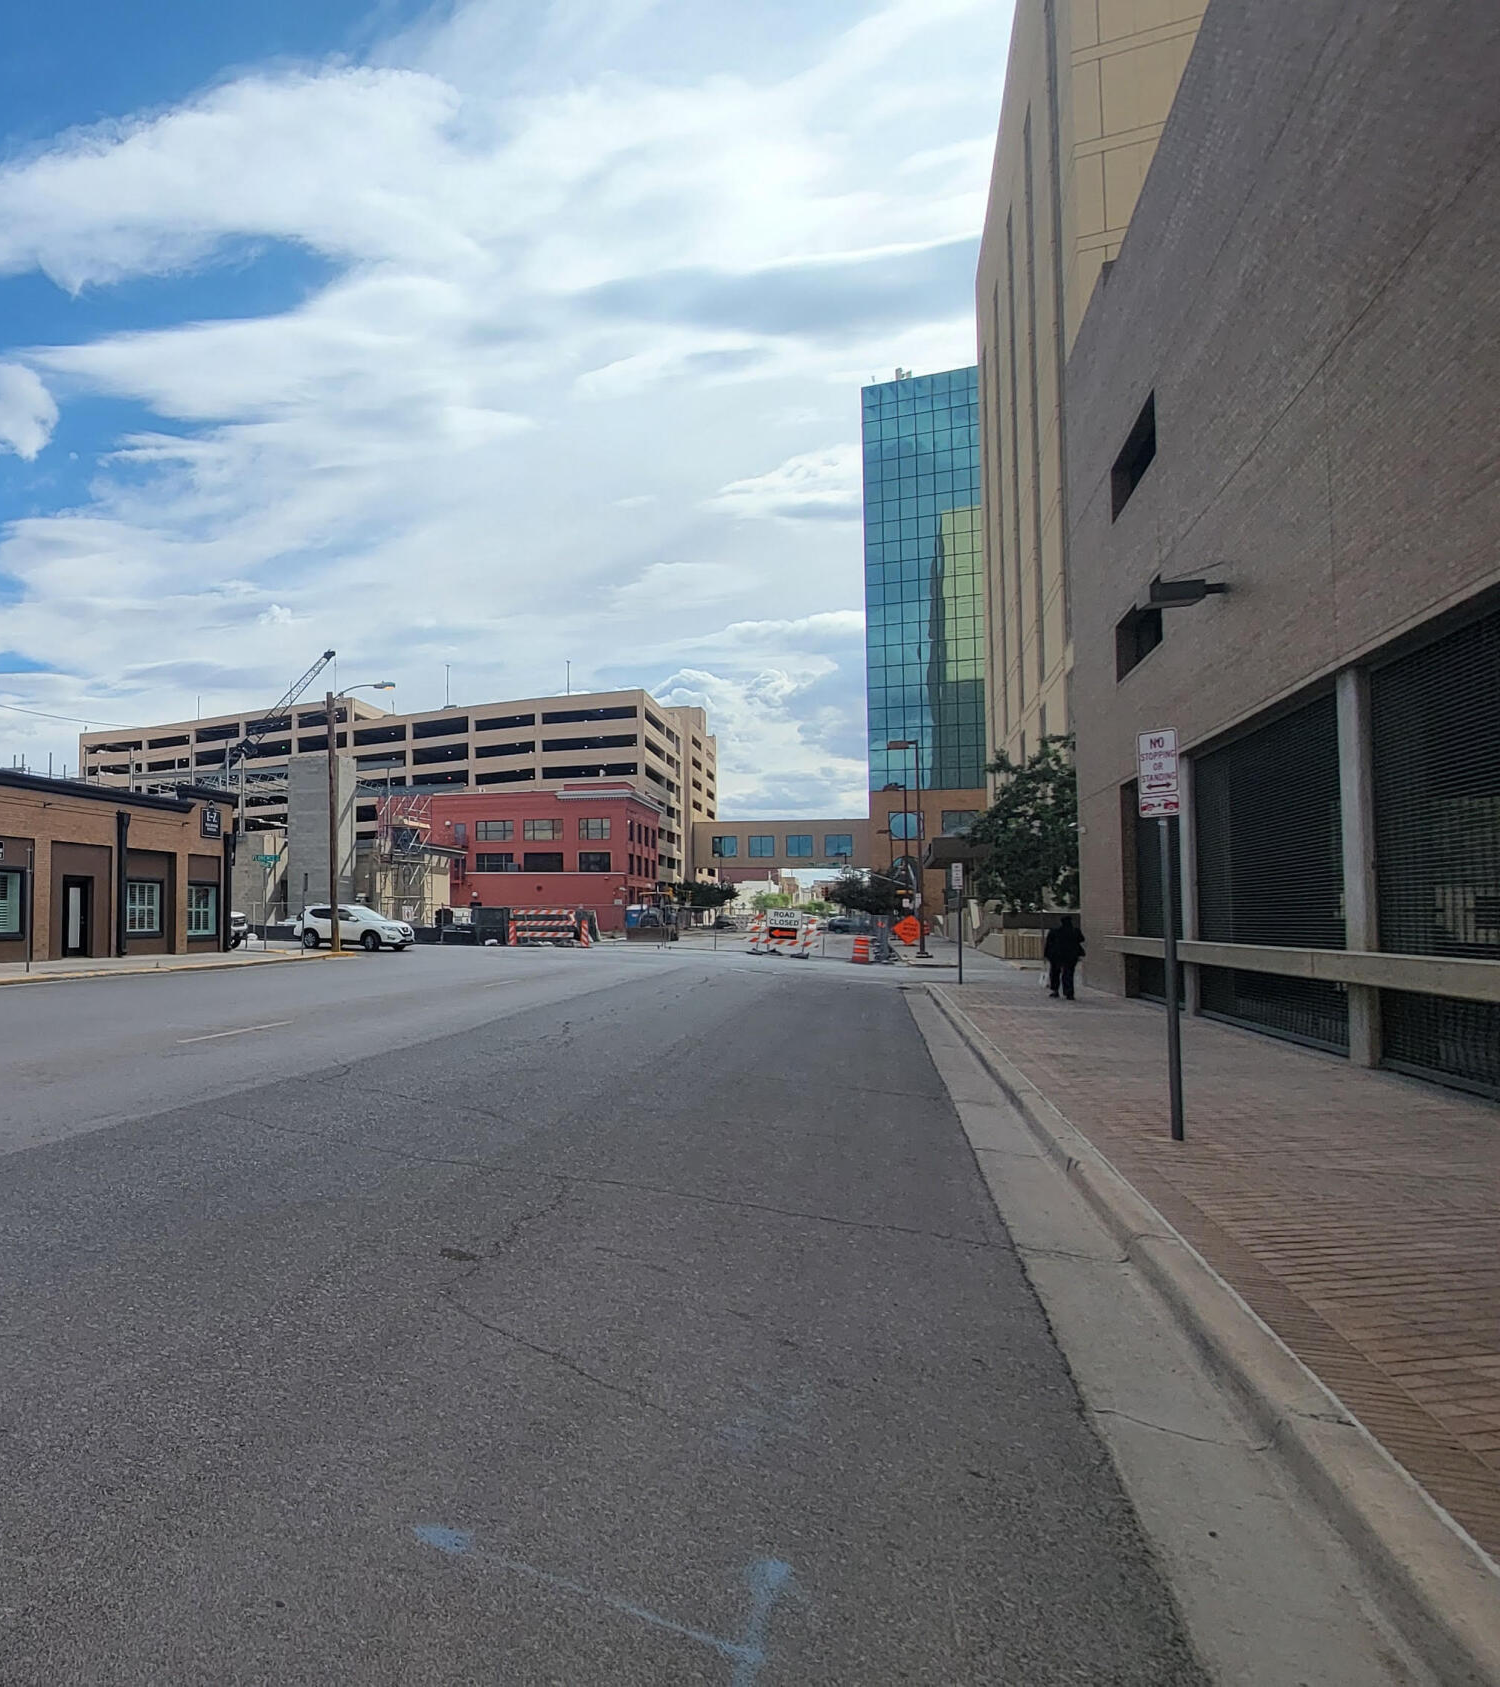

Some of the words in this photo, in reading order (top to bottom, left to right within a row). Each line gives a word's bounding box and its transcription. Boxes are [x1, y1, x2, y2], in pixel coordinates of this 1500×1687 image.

[1149, 737, 1164, 749] NO
[1140, 750, 1176, 761] STOPPING
[1153, 762, 1163, 771] OR
[1140, 772, 1176, 783] STANDING
[206, 811, 218, 823] E-Z
[769, 919, 799, 927] CLOSED
